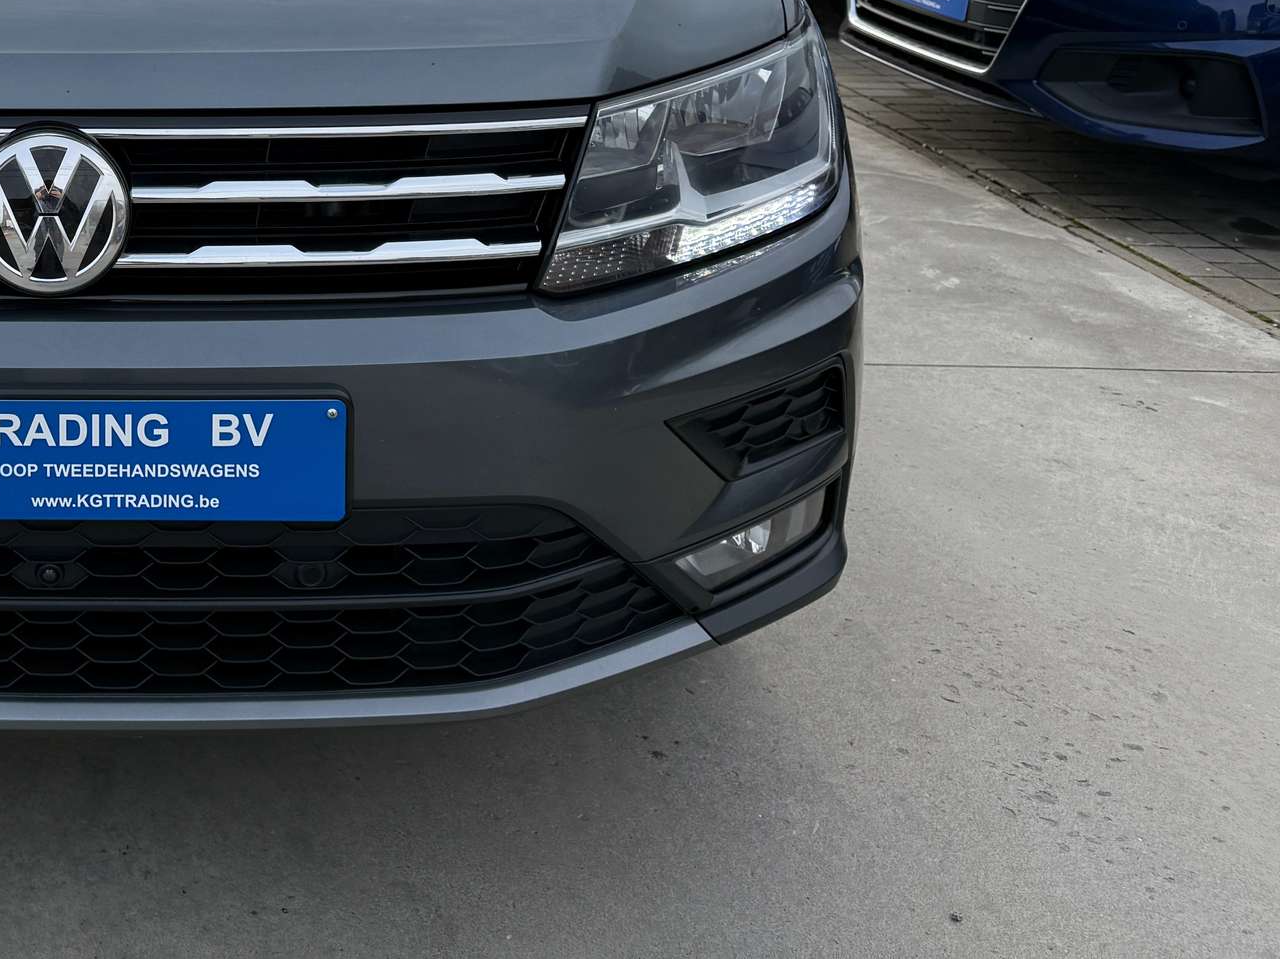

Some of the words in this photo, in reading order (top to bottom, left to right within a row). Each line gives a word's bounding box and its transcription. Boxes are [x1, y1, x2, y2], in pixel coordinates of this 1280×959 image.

[211, 413, 274, 447] BV
[42, 463, 260, 478] TWEEDEHANDSWAGENS
[31, 493, 220, 509] www.KGTTRADING.be
